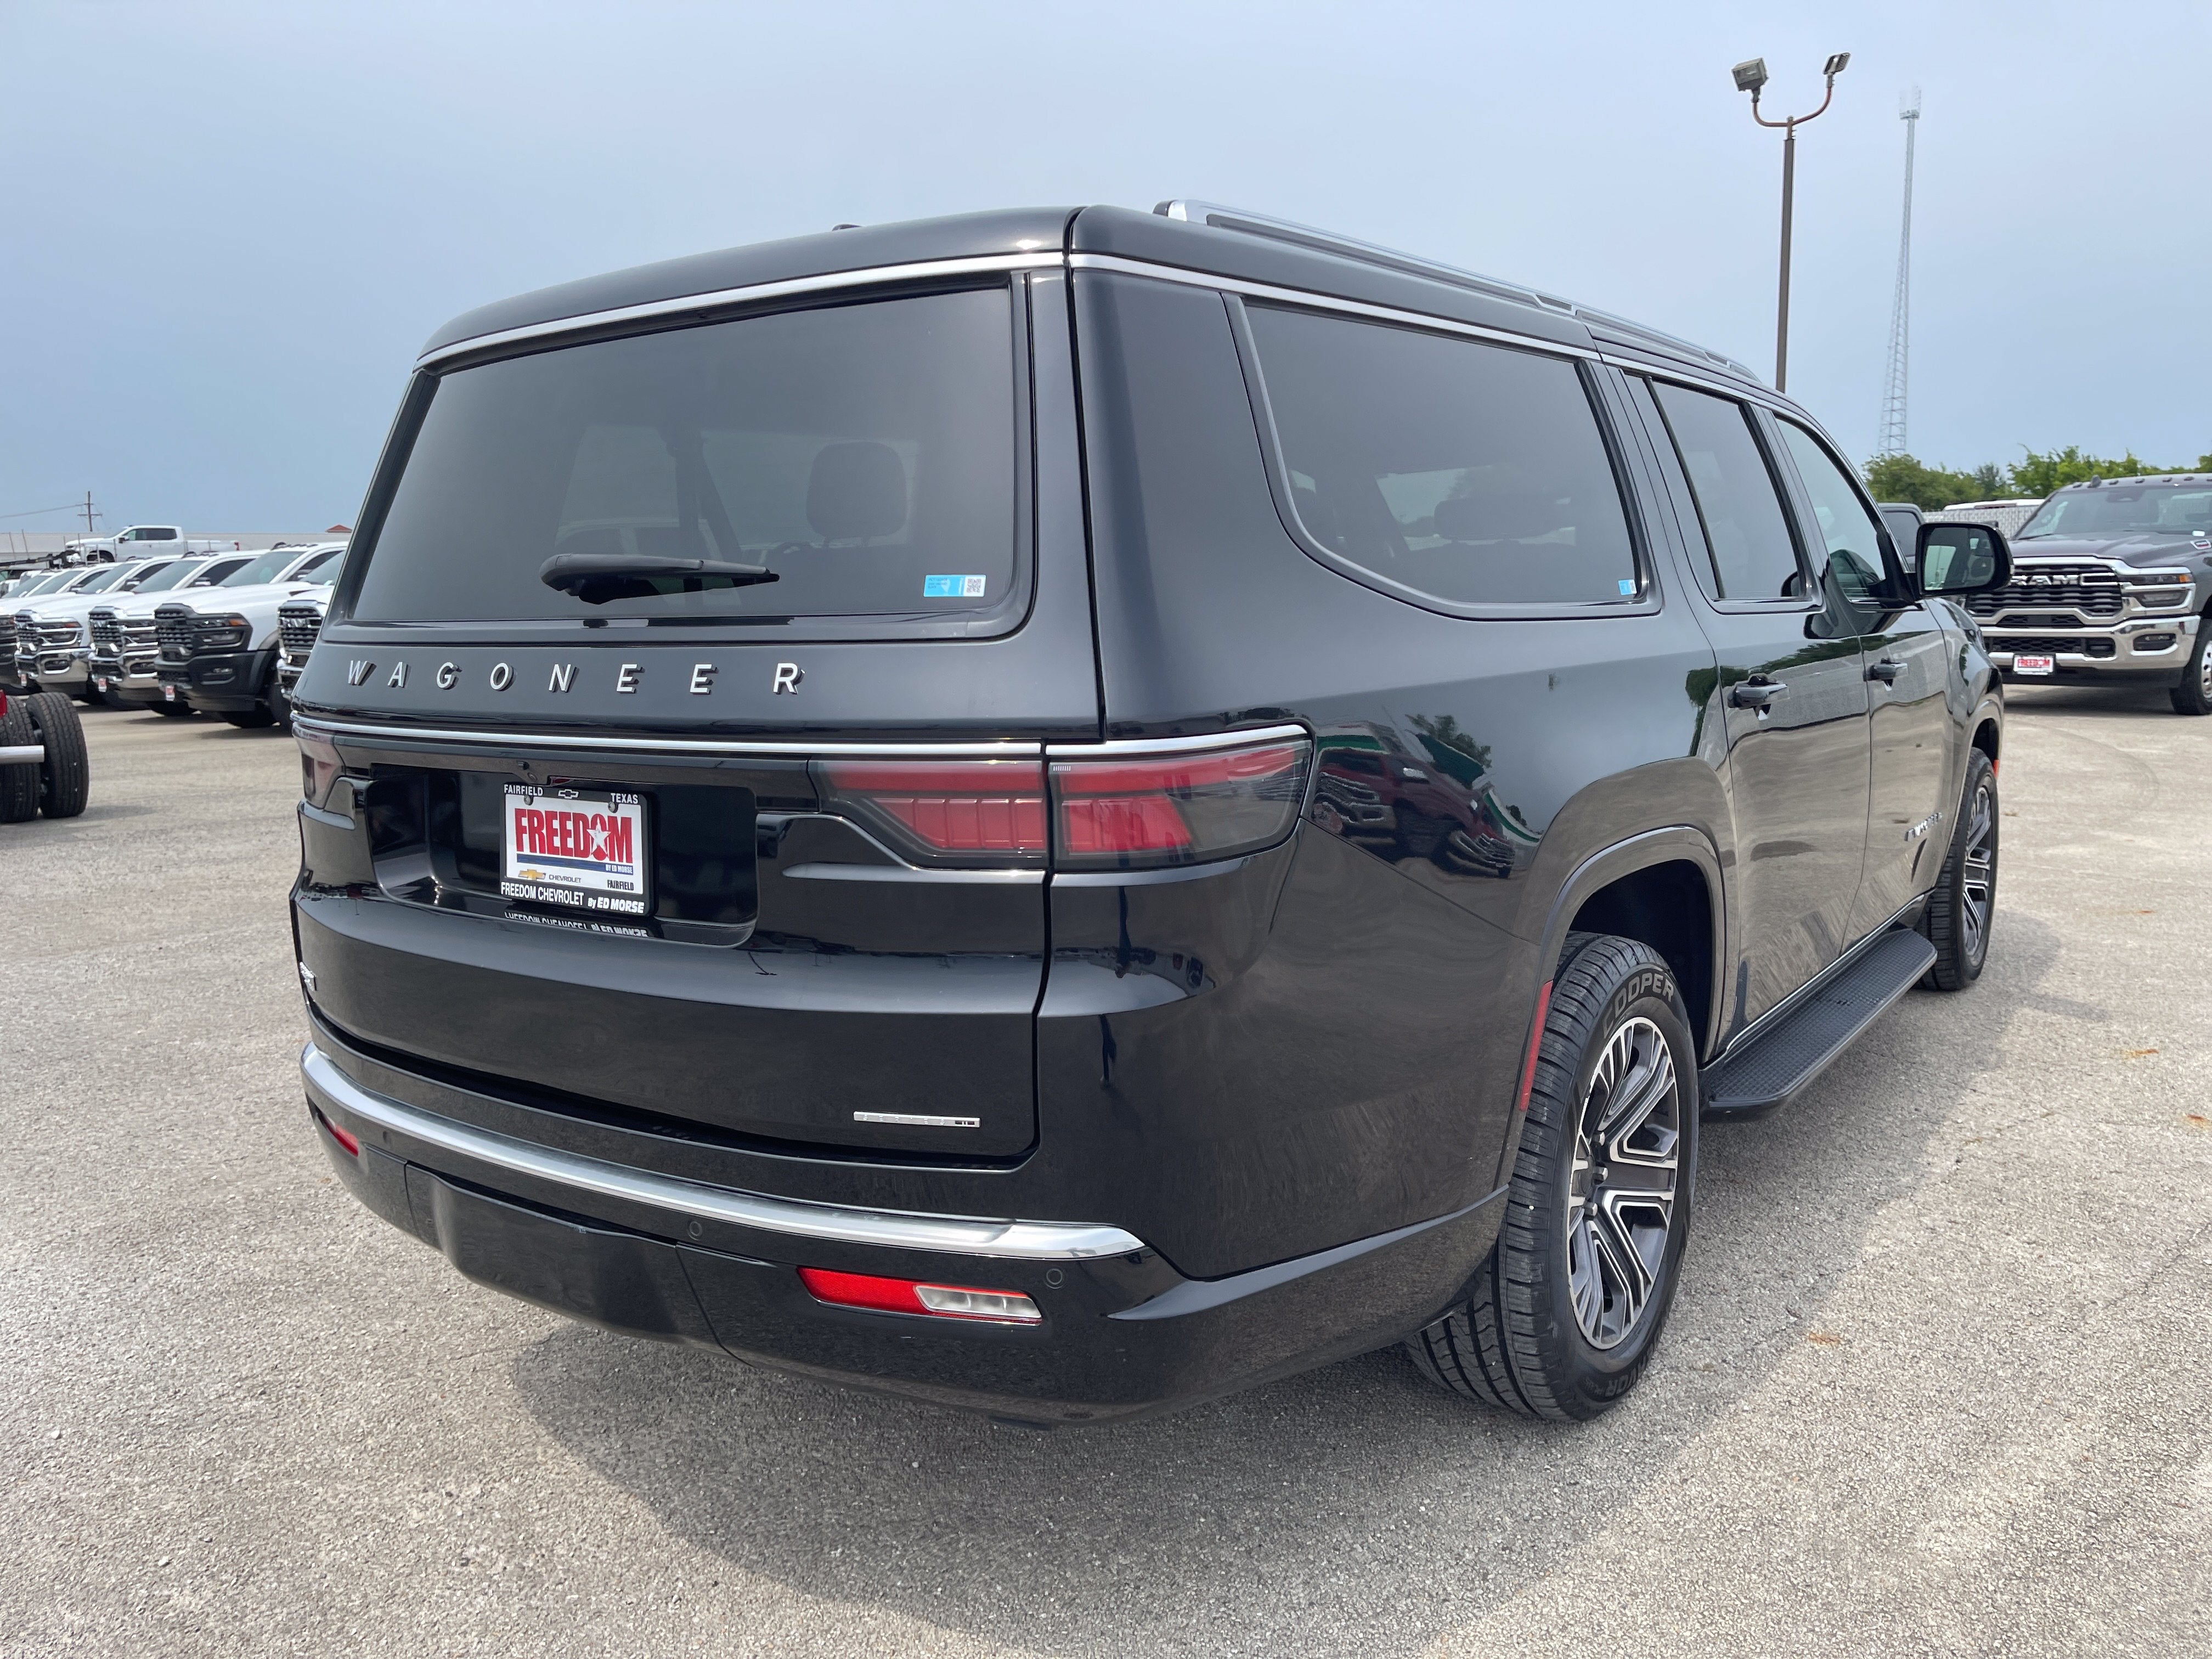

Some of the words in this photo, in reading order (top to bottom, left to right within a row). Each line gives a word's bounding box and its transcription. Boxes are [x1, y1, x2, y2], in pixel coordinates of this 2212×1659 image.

[2008, 575, 2078, 585] RAM
[347, 660, 805, 695] WAGONEER
[504, 784, 543, 796] FAIRFIELD
[611, 793, 639, 804] TEXAS
[515, 808, 633, 863] FREEDOM
[618, 866, 633, 874] MORSE
[549, 874, 582, 883] CHEVROLET
[607, 879, 634, 891] FAIRFIELD
[501, 882, 536, 899] FREEDOM
[538, 887, 584, 906] CHEVROLET
[588, 898, 596, 909] By
[597, 896, 610, 908] ED
[612, 899, 645, 914] MORSE
[1602, 972, 1675, 1039] COOPER
